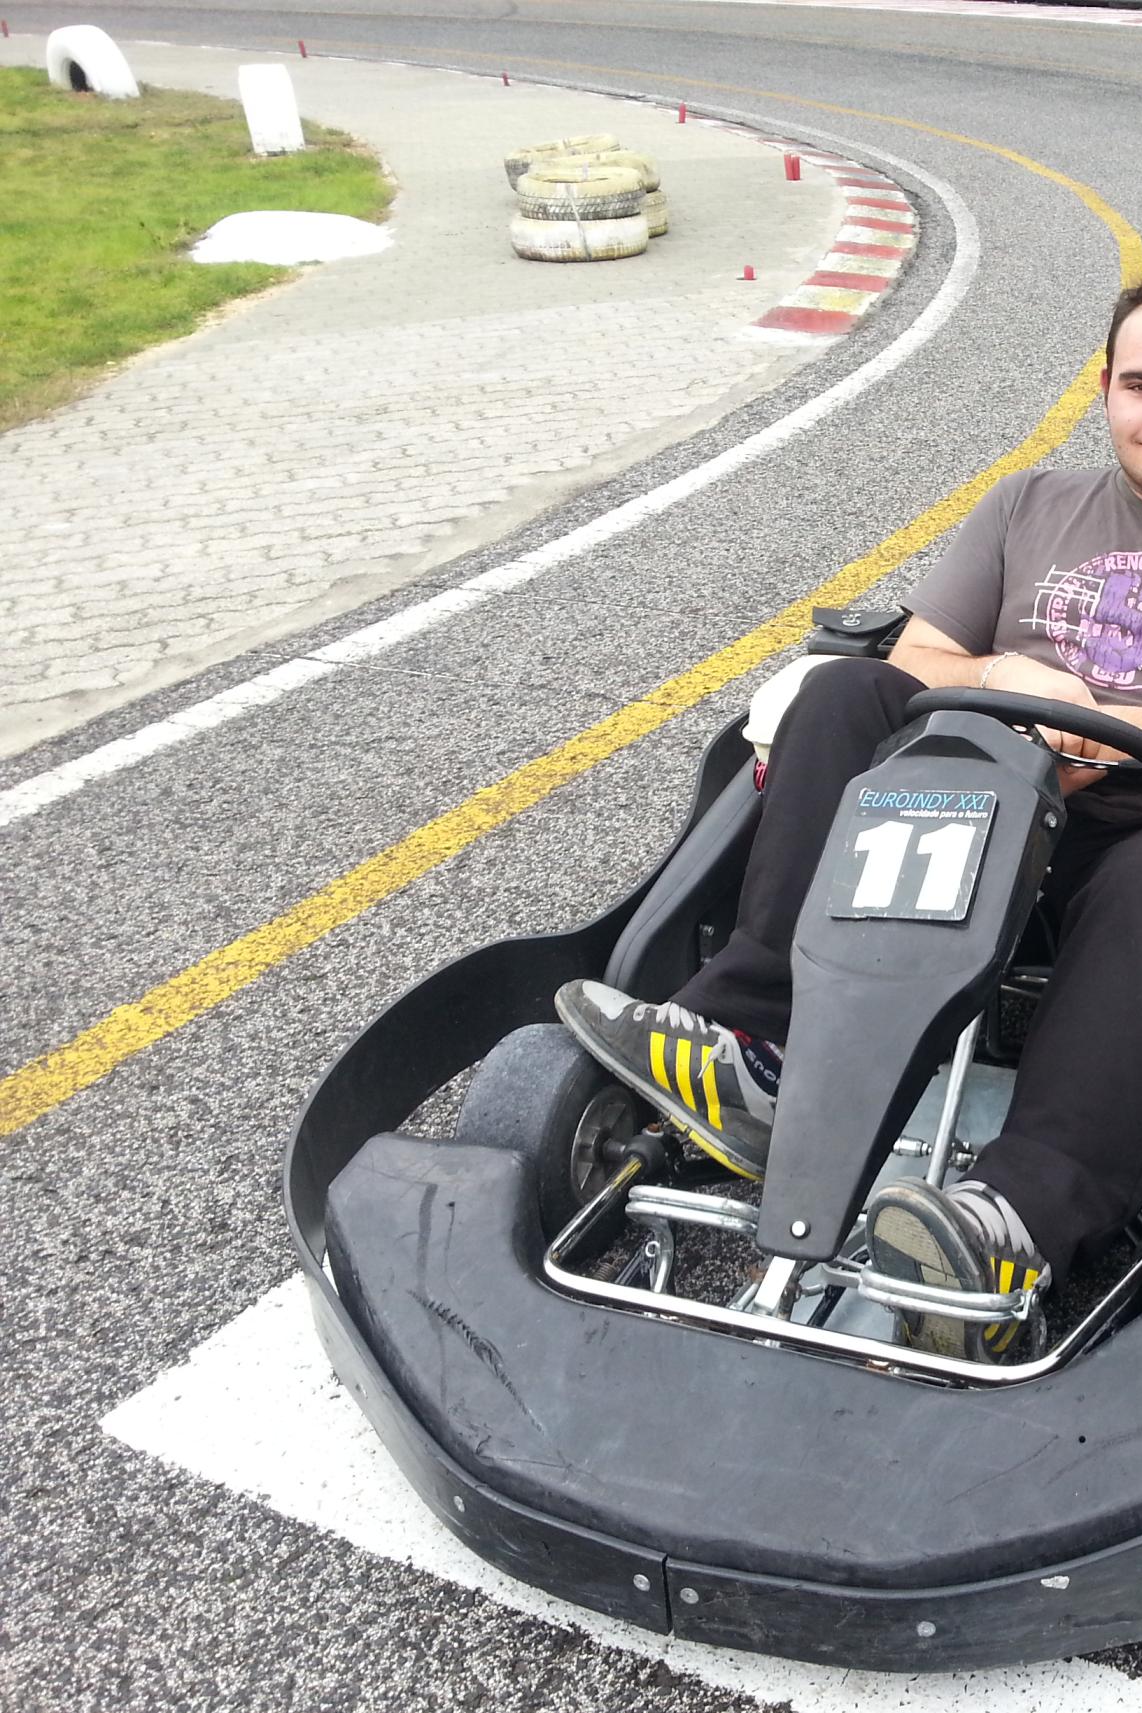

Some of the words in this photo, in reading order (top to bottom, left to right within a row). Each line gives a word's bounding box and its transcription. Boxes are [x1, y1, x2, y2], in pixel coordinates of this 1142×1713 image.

[860, 791, 956, 811] EUROINDY
[957, 794, 990, 811] XXI
[939, 810, 957, 819] para
[965, 810, 989, 819] futuro
[852, 820, 977, 911] 11
